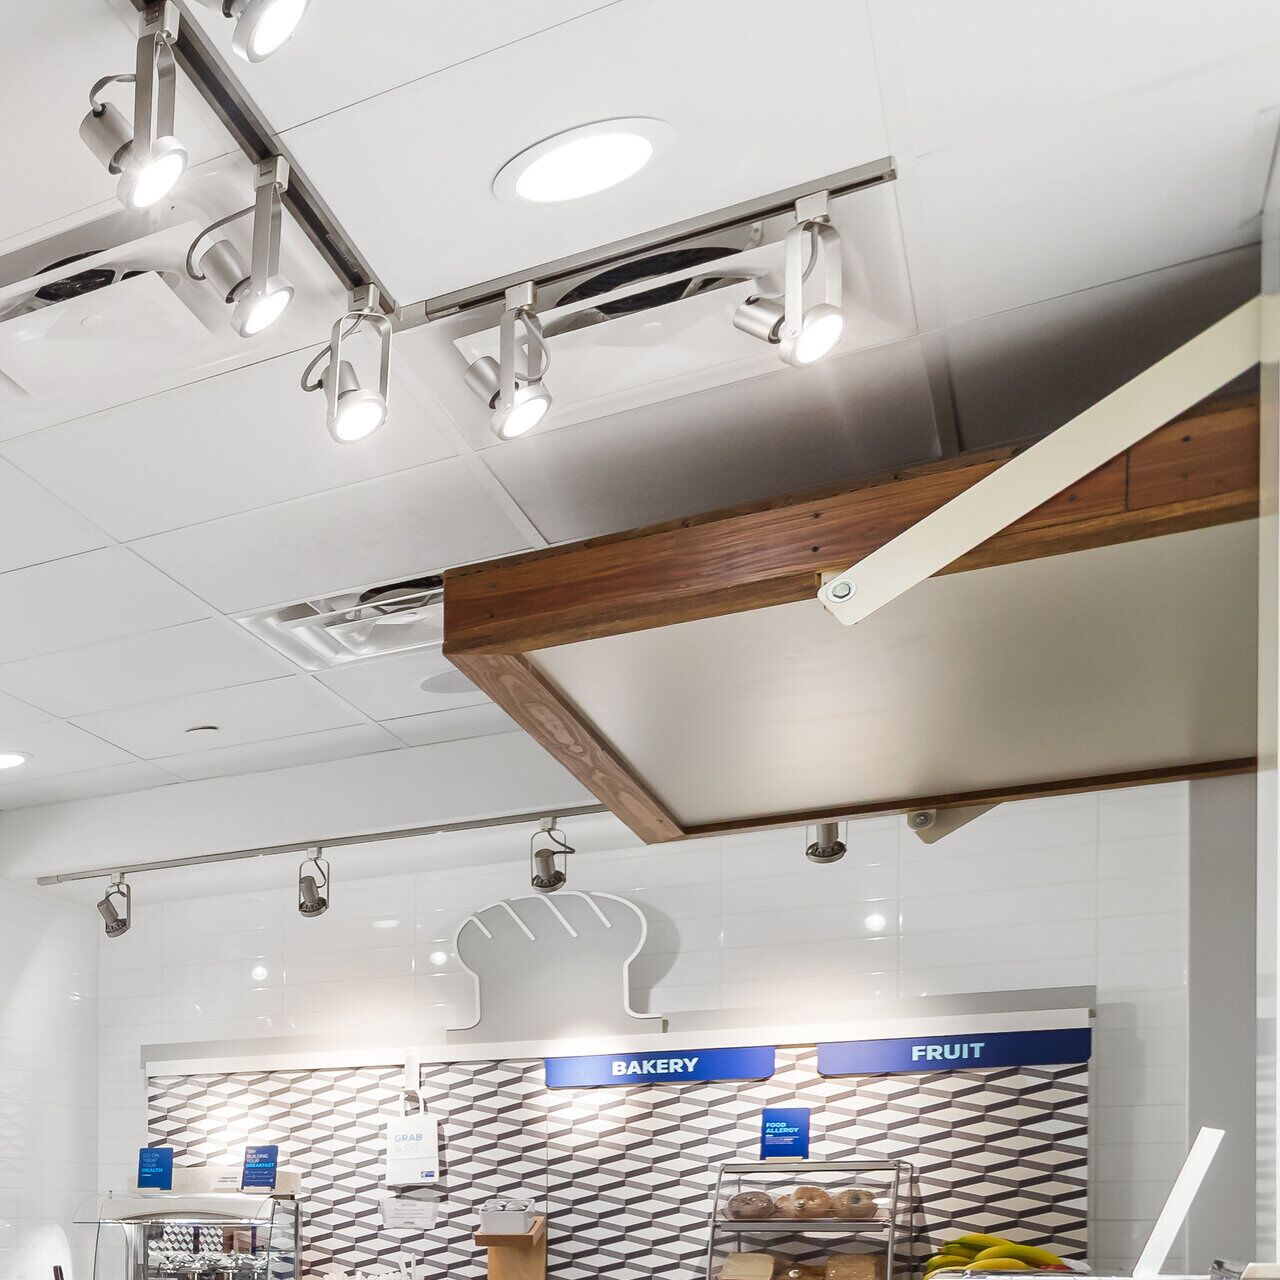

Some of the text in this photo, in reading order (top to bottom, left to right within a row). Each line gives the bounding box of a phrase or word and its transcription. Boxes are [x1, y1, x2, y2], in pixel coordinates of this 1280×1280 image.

[912, 1043, 986, 1062] FRUIT
[612, 1057, 699, 1077] BAKERY
[394, 1133, 423, 1143] GRAB
